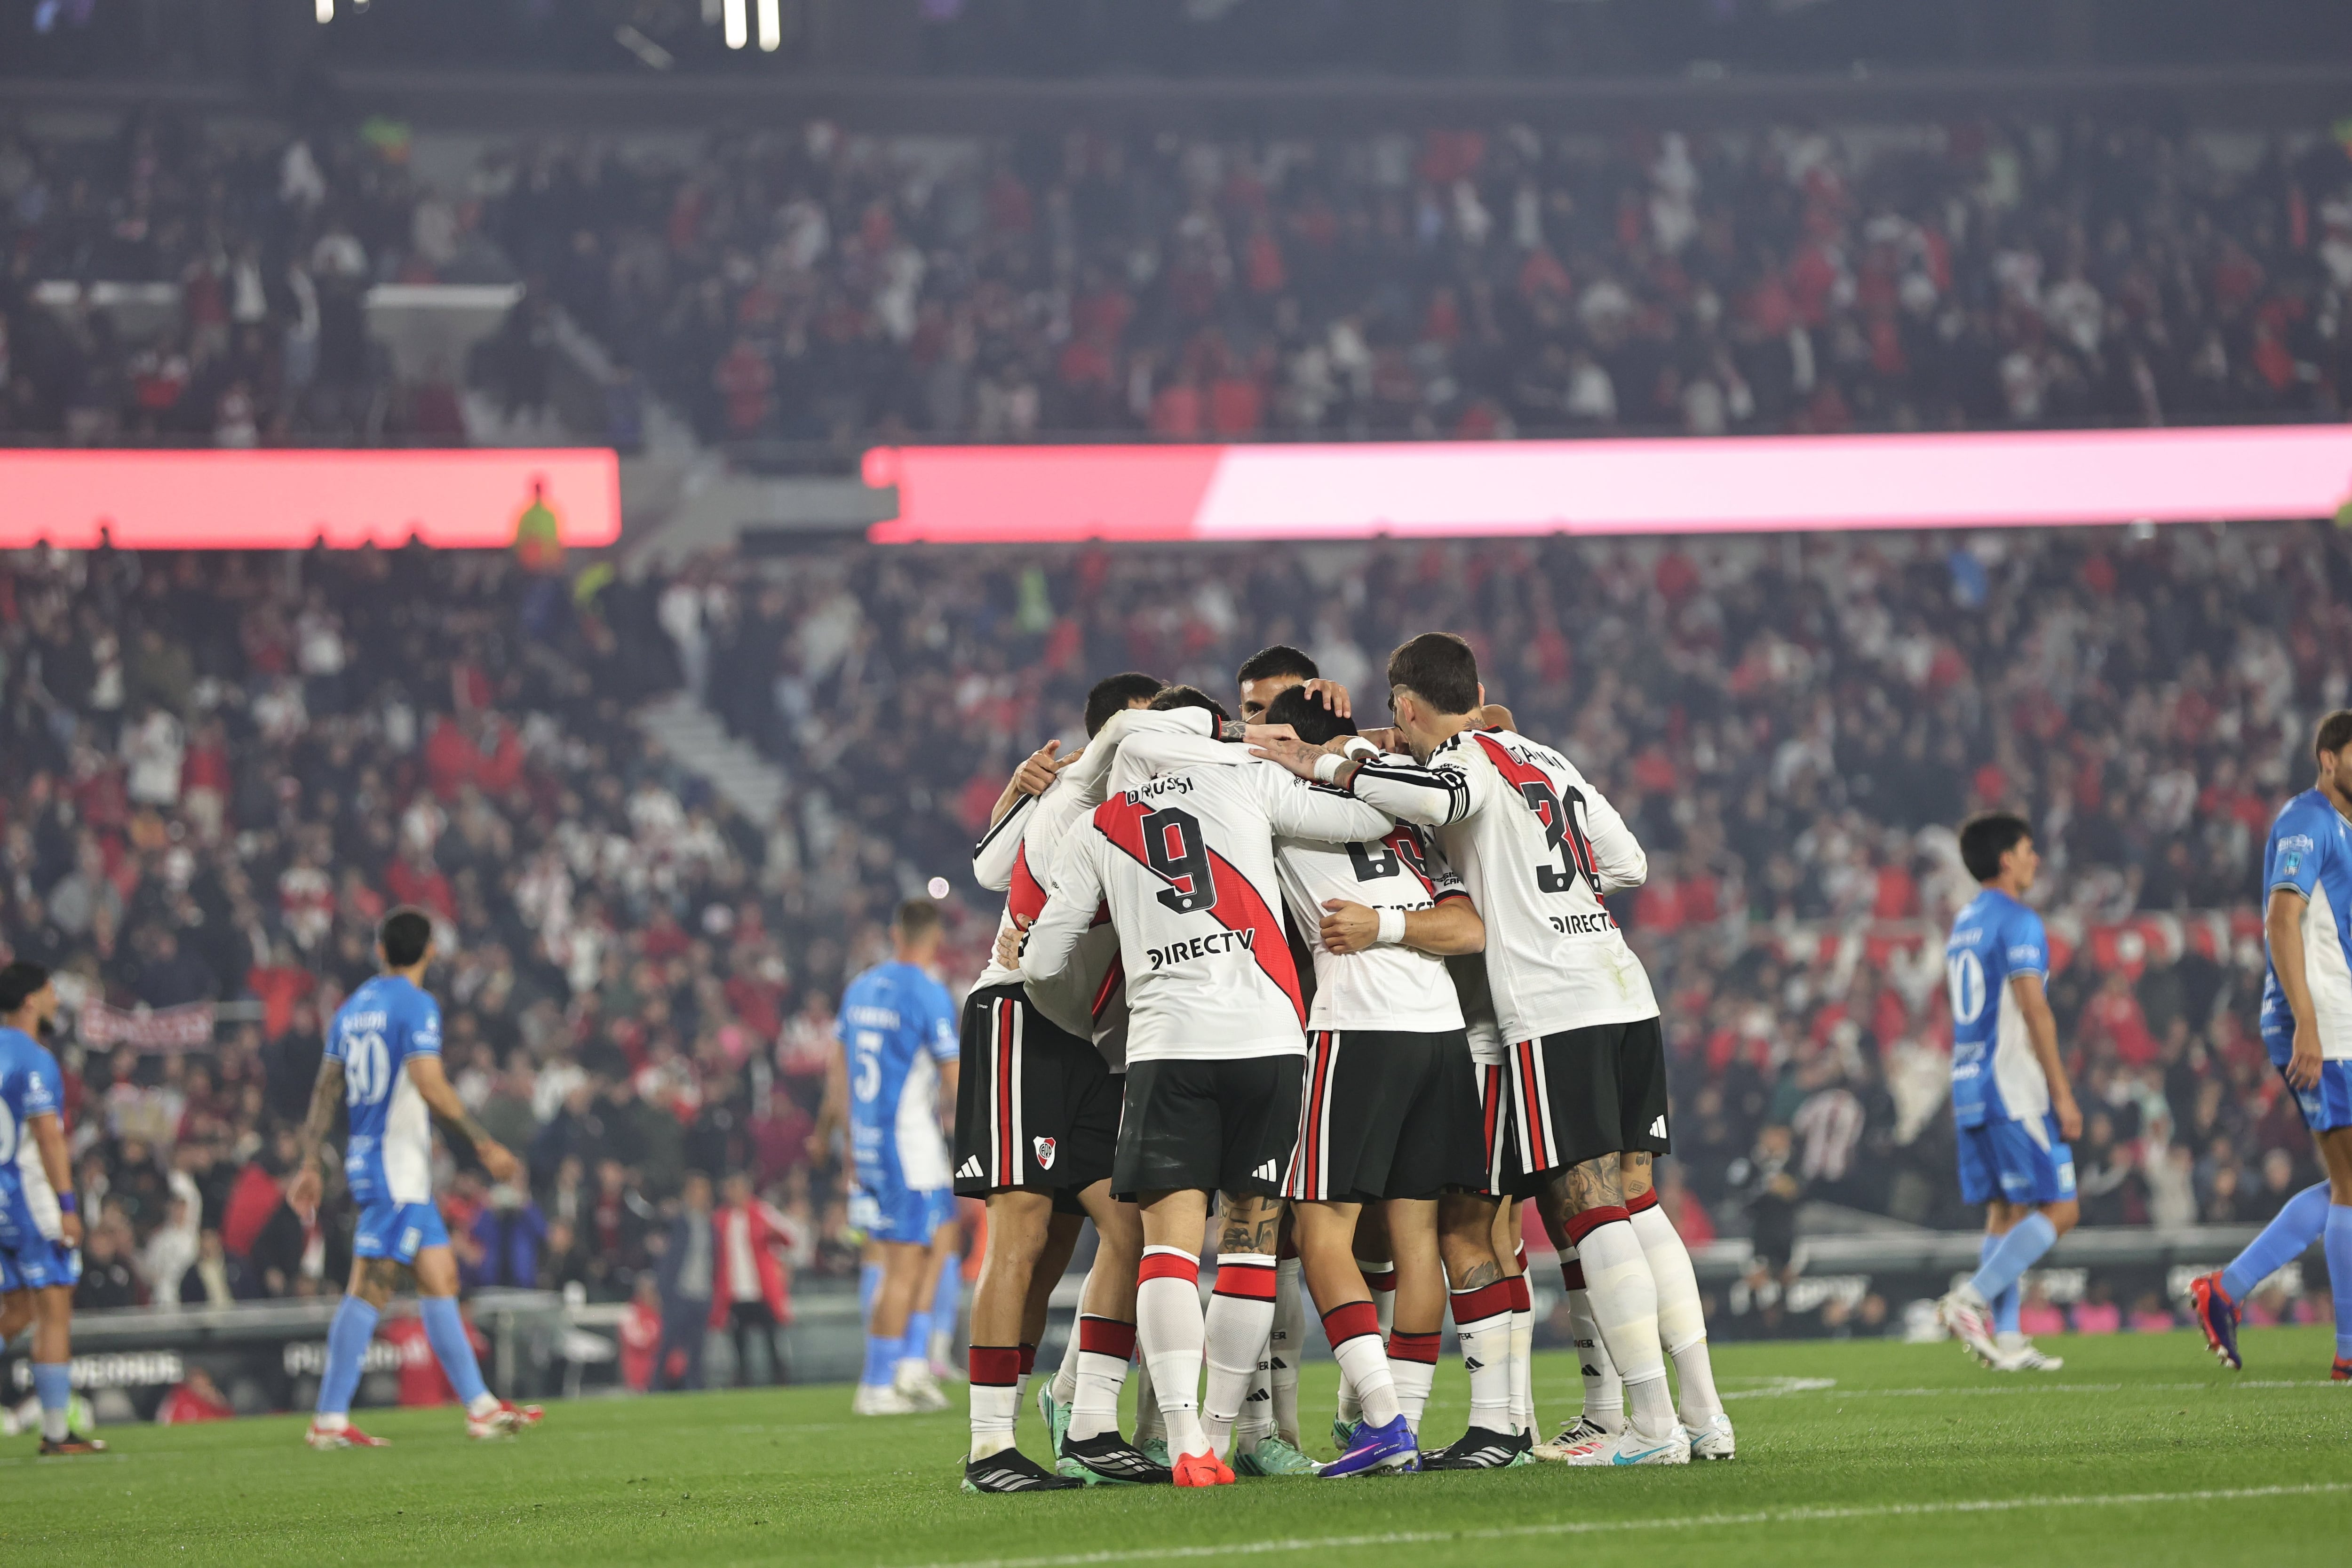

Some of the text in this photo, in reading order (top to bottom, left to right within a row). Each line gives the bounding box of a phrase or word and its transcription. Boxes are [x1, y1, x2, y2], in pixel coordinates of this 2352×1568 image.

[1140, 806, 1217, 915] 9
[1520, 782, 1603, 894] 30
[1146, 929, 1254, 971] DIRECTV
[854, 1030, 884, 1104] 5
